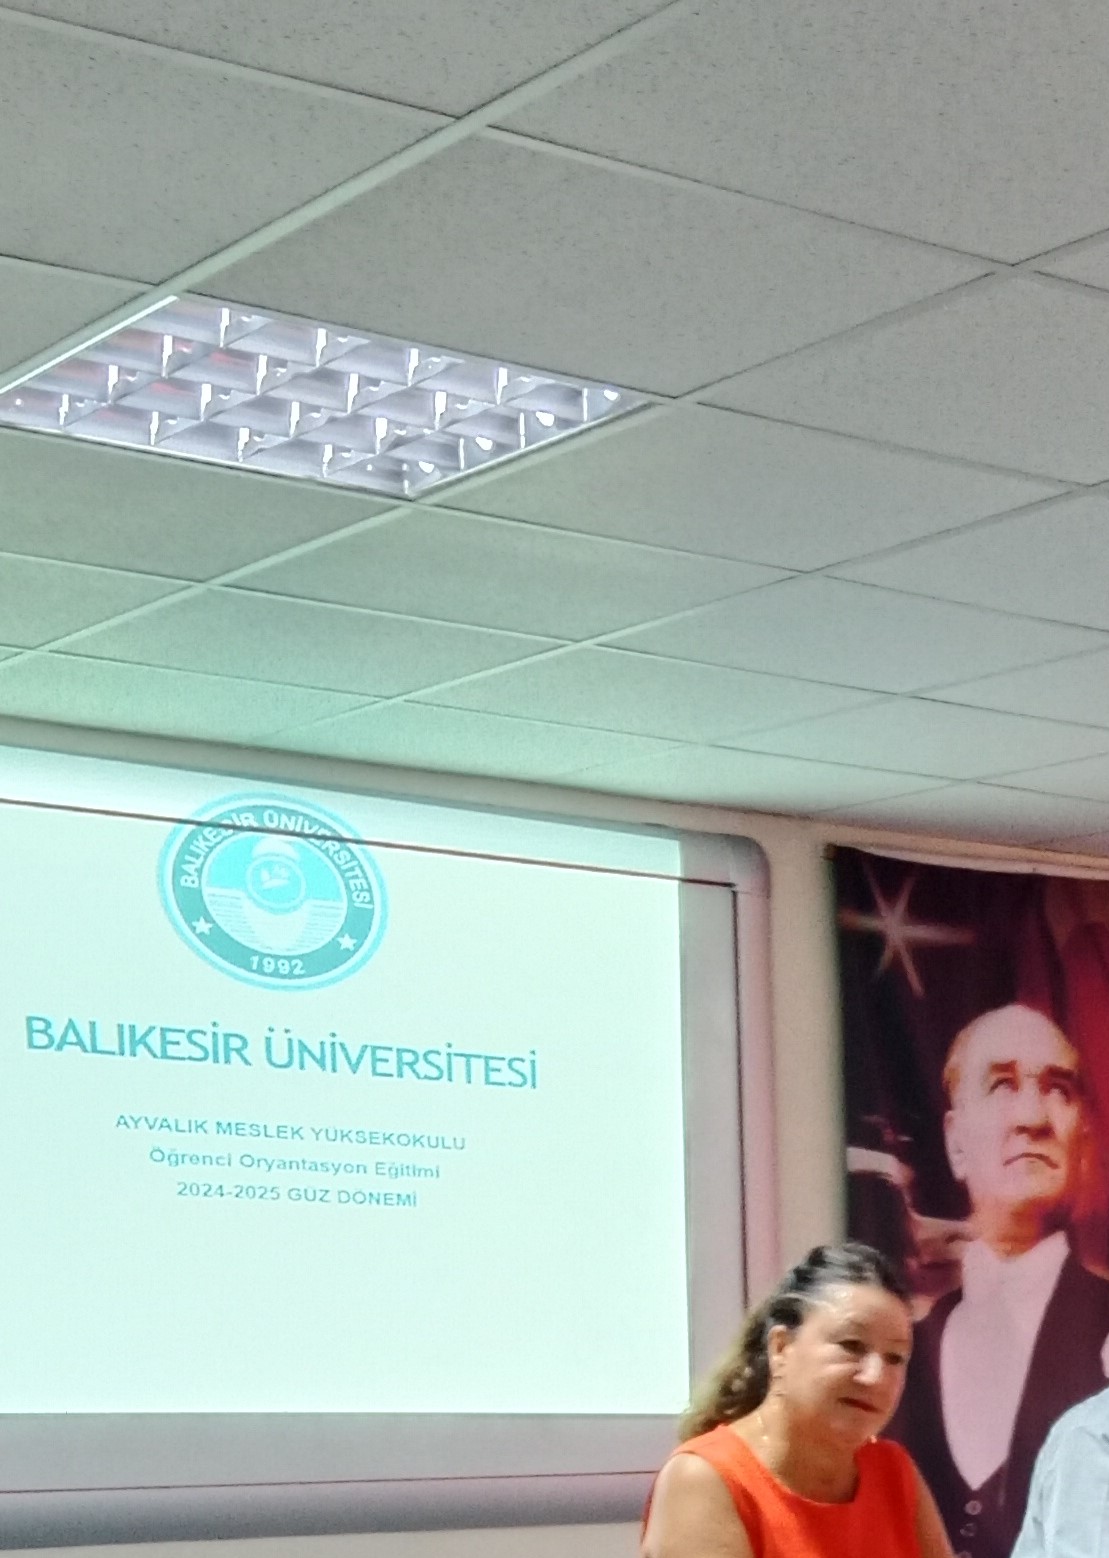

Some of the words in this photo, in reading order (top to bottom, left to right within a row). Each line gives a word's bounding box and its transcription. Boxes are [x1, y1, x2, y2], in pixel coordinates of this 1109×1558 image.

[250, 955, 306, 975] 1992
[25, 1015, 252, 1067] BALIKESİR
[264, 1026, 538, 1089] ÜNİVERSİTESİ
[115, 1114, 209, 1135] AYVALIK
[216, 1120, 305, 1141] MESLEK
[310, 1124, 466, 1151] YÜKSEKOKULU
[149, 1145, 232, 1167] Öğrenci
[239, 1153, 368, 1176] Oryantasyon
[375, 1161, 441, 1179] Eğitimi
[176, 1181, 281, 1201] 2024-2025
